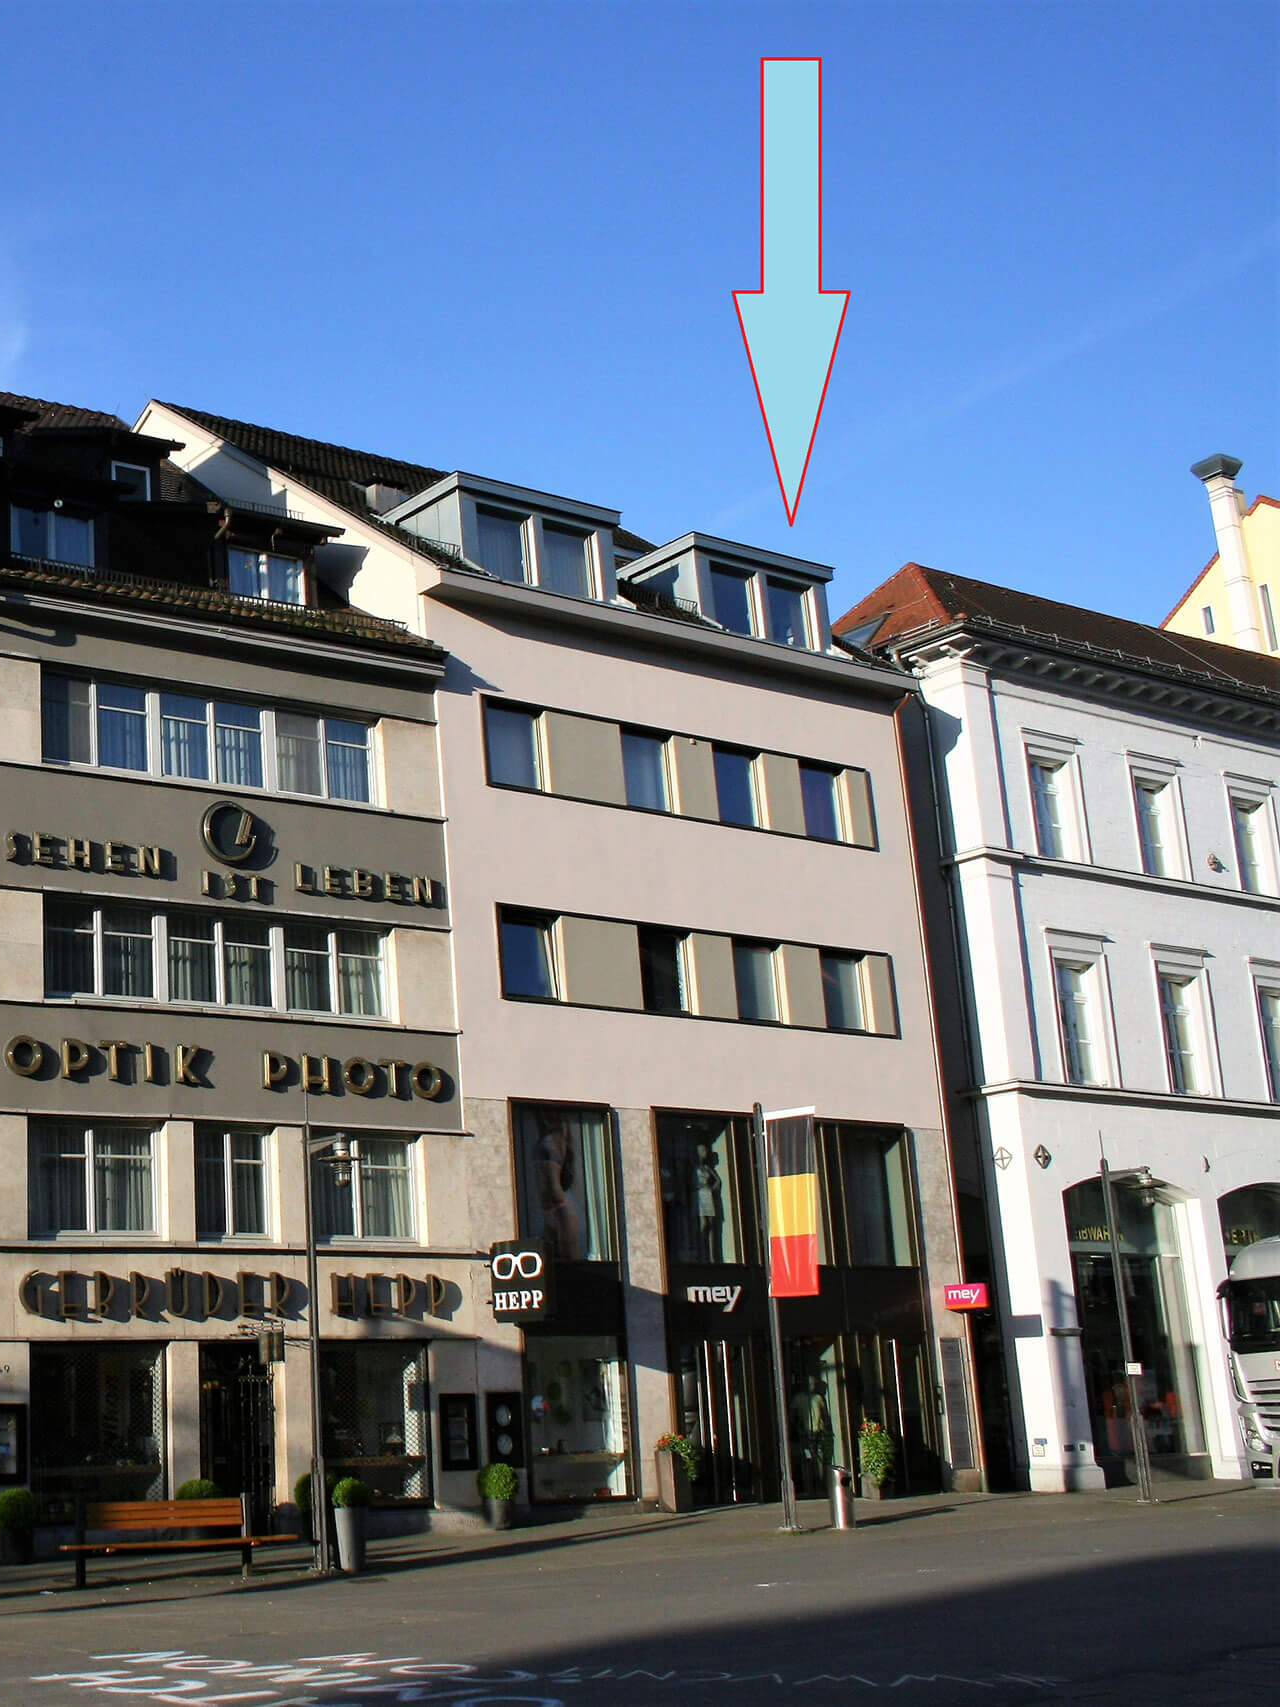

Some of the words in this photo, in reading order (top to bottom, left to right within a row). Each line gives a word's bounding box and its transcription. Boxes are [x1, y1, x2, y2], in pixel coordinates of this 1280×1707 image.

[5, 831, 162, 876] SEHEN
[202, 869, 262, 900] IST
[294, 862, 434, 904] LEBEN
[4, 1034, 201, 1085] OPTIK
[260, 1048, 443, 1098] PHOTO
[19, 1268, 300, 1317] GEBRÜDER
[329, 1271, 447, 1317] HEPP
[494, 1289, 543, 1311] HEPP
[687, 1286, 741, 1312] mey
[947, 1288, 980, 1304] mey
